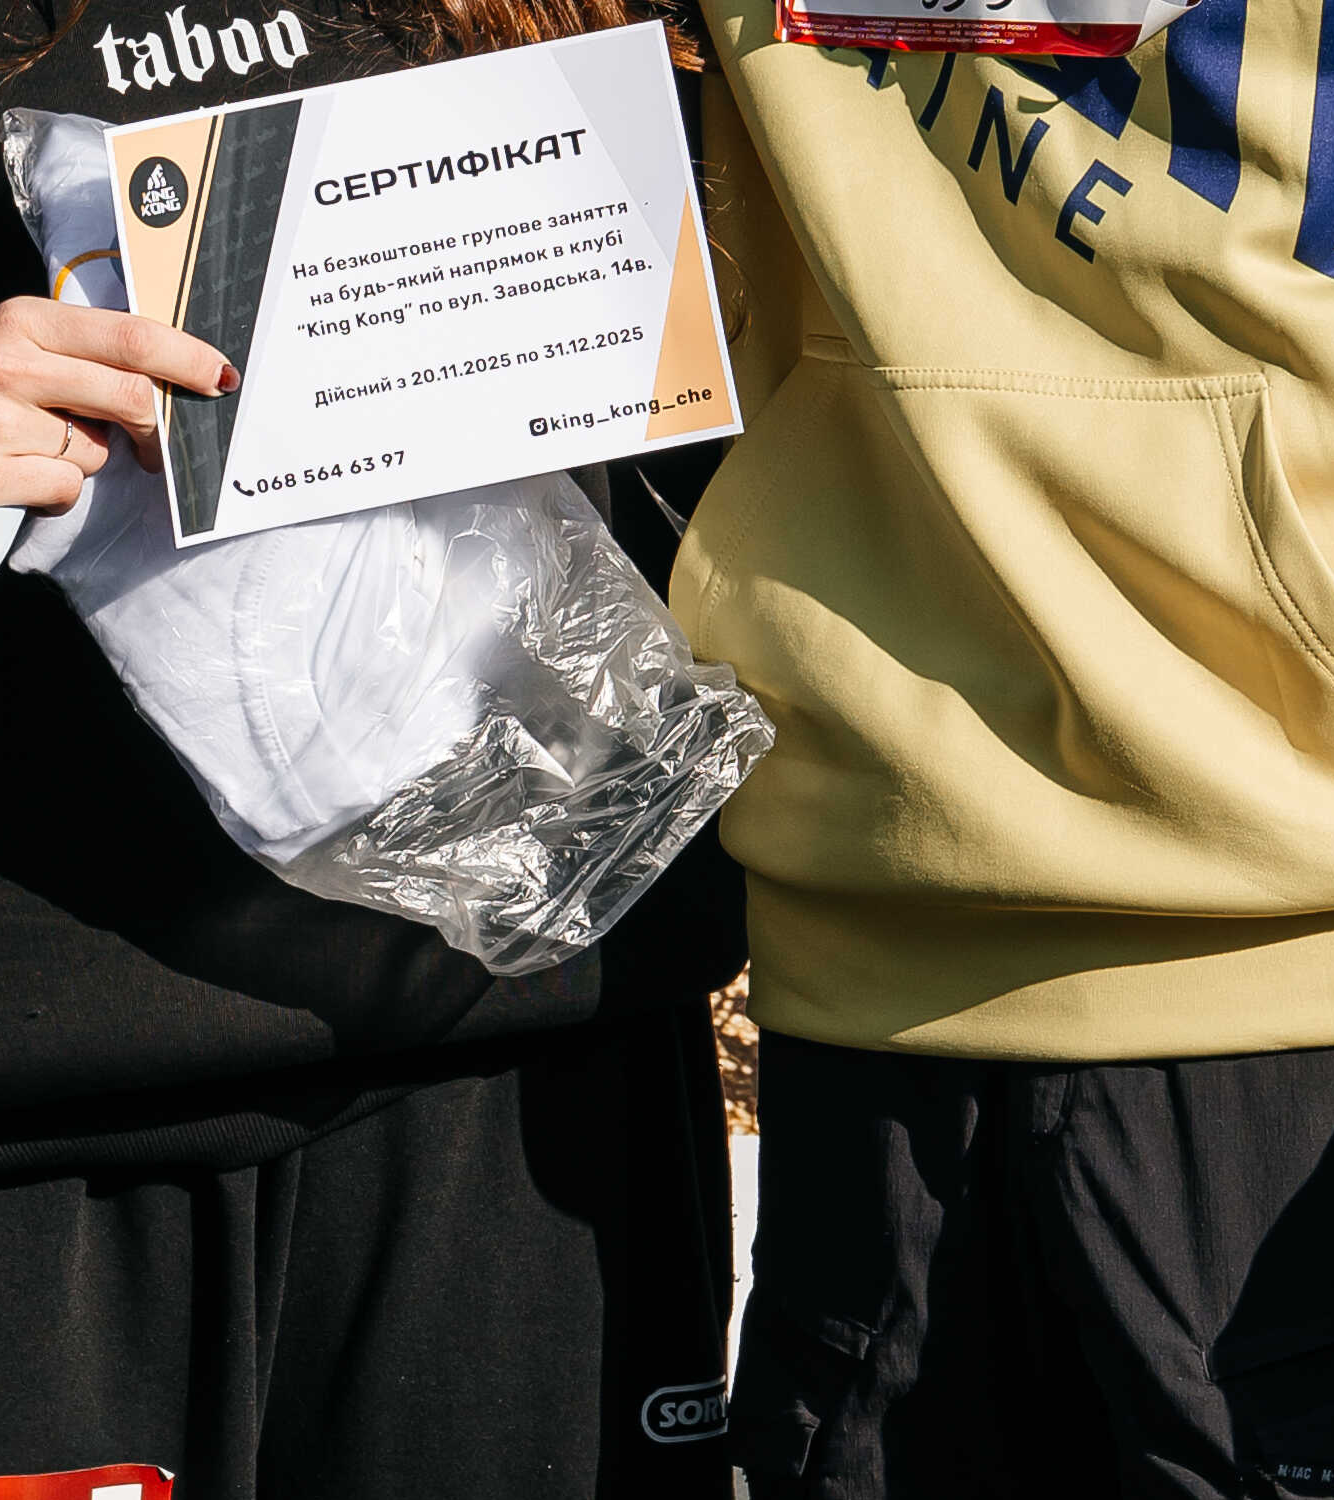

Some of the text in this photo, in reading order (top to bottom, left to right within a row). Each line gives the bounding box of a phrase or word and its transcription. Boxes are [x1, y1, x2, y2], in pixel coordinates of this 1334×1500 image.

[93, 4, 310, 95] taboo
[142, 186, 176, 204] KING
[314, 128, 586, 206] СЕРТИФІКАТ
[141, 198, 181, 217] KONG
[292, 202, 628, 280] На безкоштовне групове заняття
[310, 229, 623, 307] на будь-який напрямок в клубі
[419, 300, 443, 316] по
[448, 292, 489, 311] вул.
[493, 268, 606, 300] Заводська,
[610, 258, 652, 276] 14в.
[315, 326, 644, 408] Дійсний з 20.11.2025 по 31.12.2025
[550, 387, 713, 432] king_kong_che
[256, 450, 405, 494] 068 564 63 97
